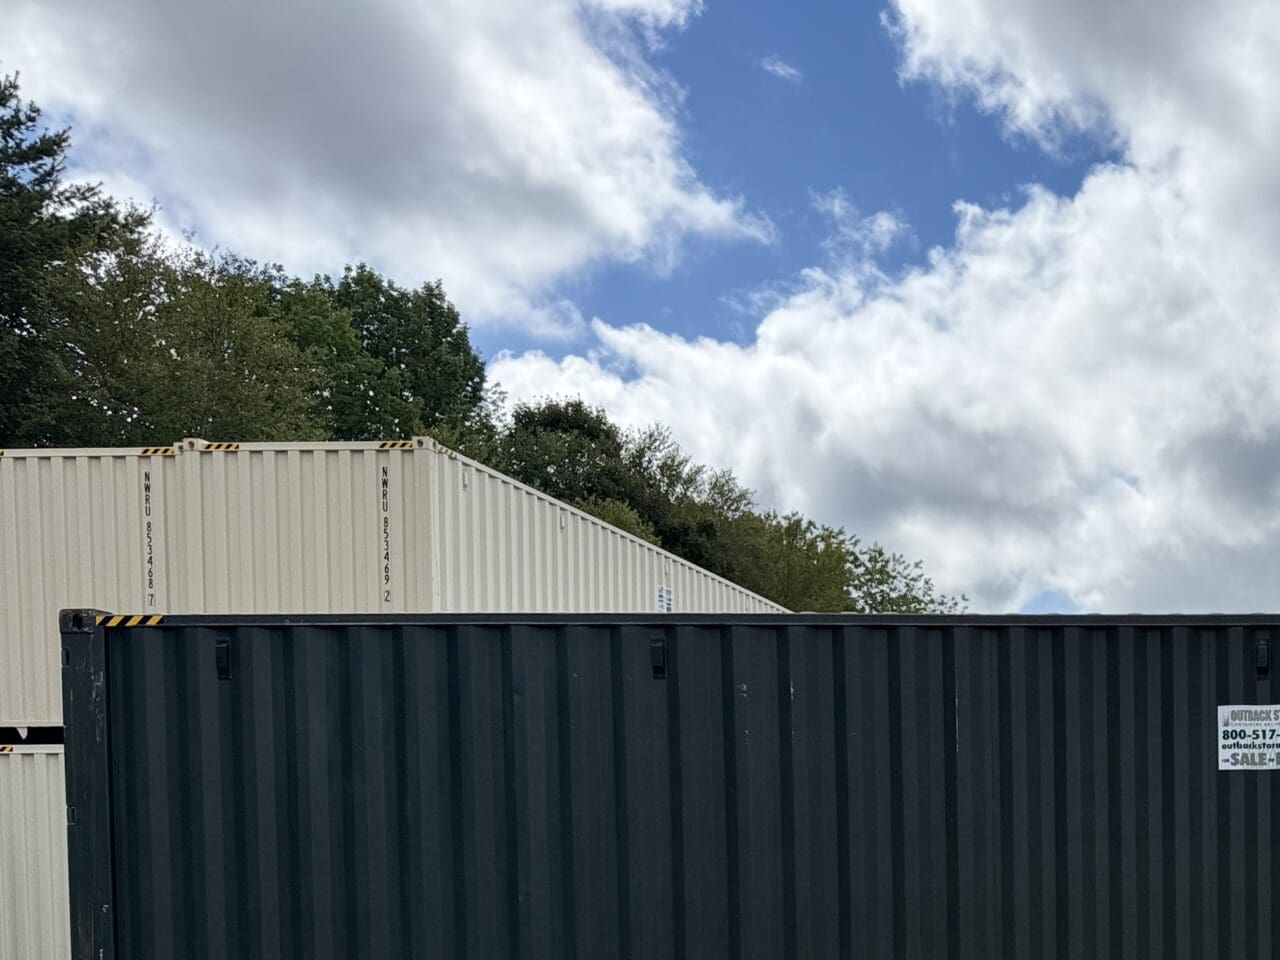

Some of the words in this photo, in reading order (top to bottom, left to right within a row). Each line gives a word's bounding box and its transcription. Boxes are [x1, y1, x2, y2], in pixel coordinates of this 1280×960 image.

[143, 471, 151, 516] NWRU
[1230, 709, 1272, 722] OUTBACK
[1230, 752, 1267, 766] SALE
